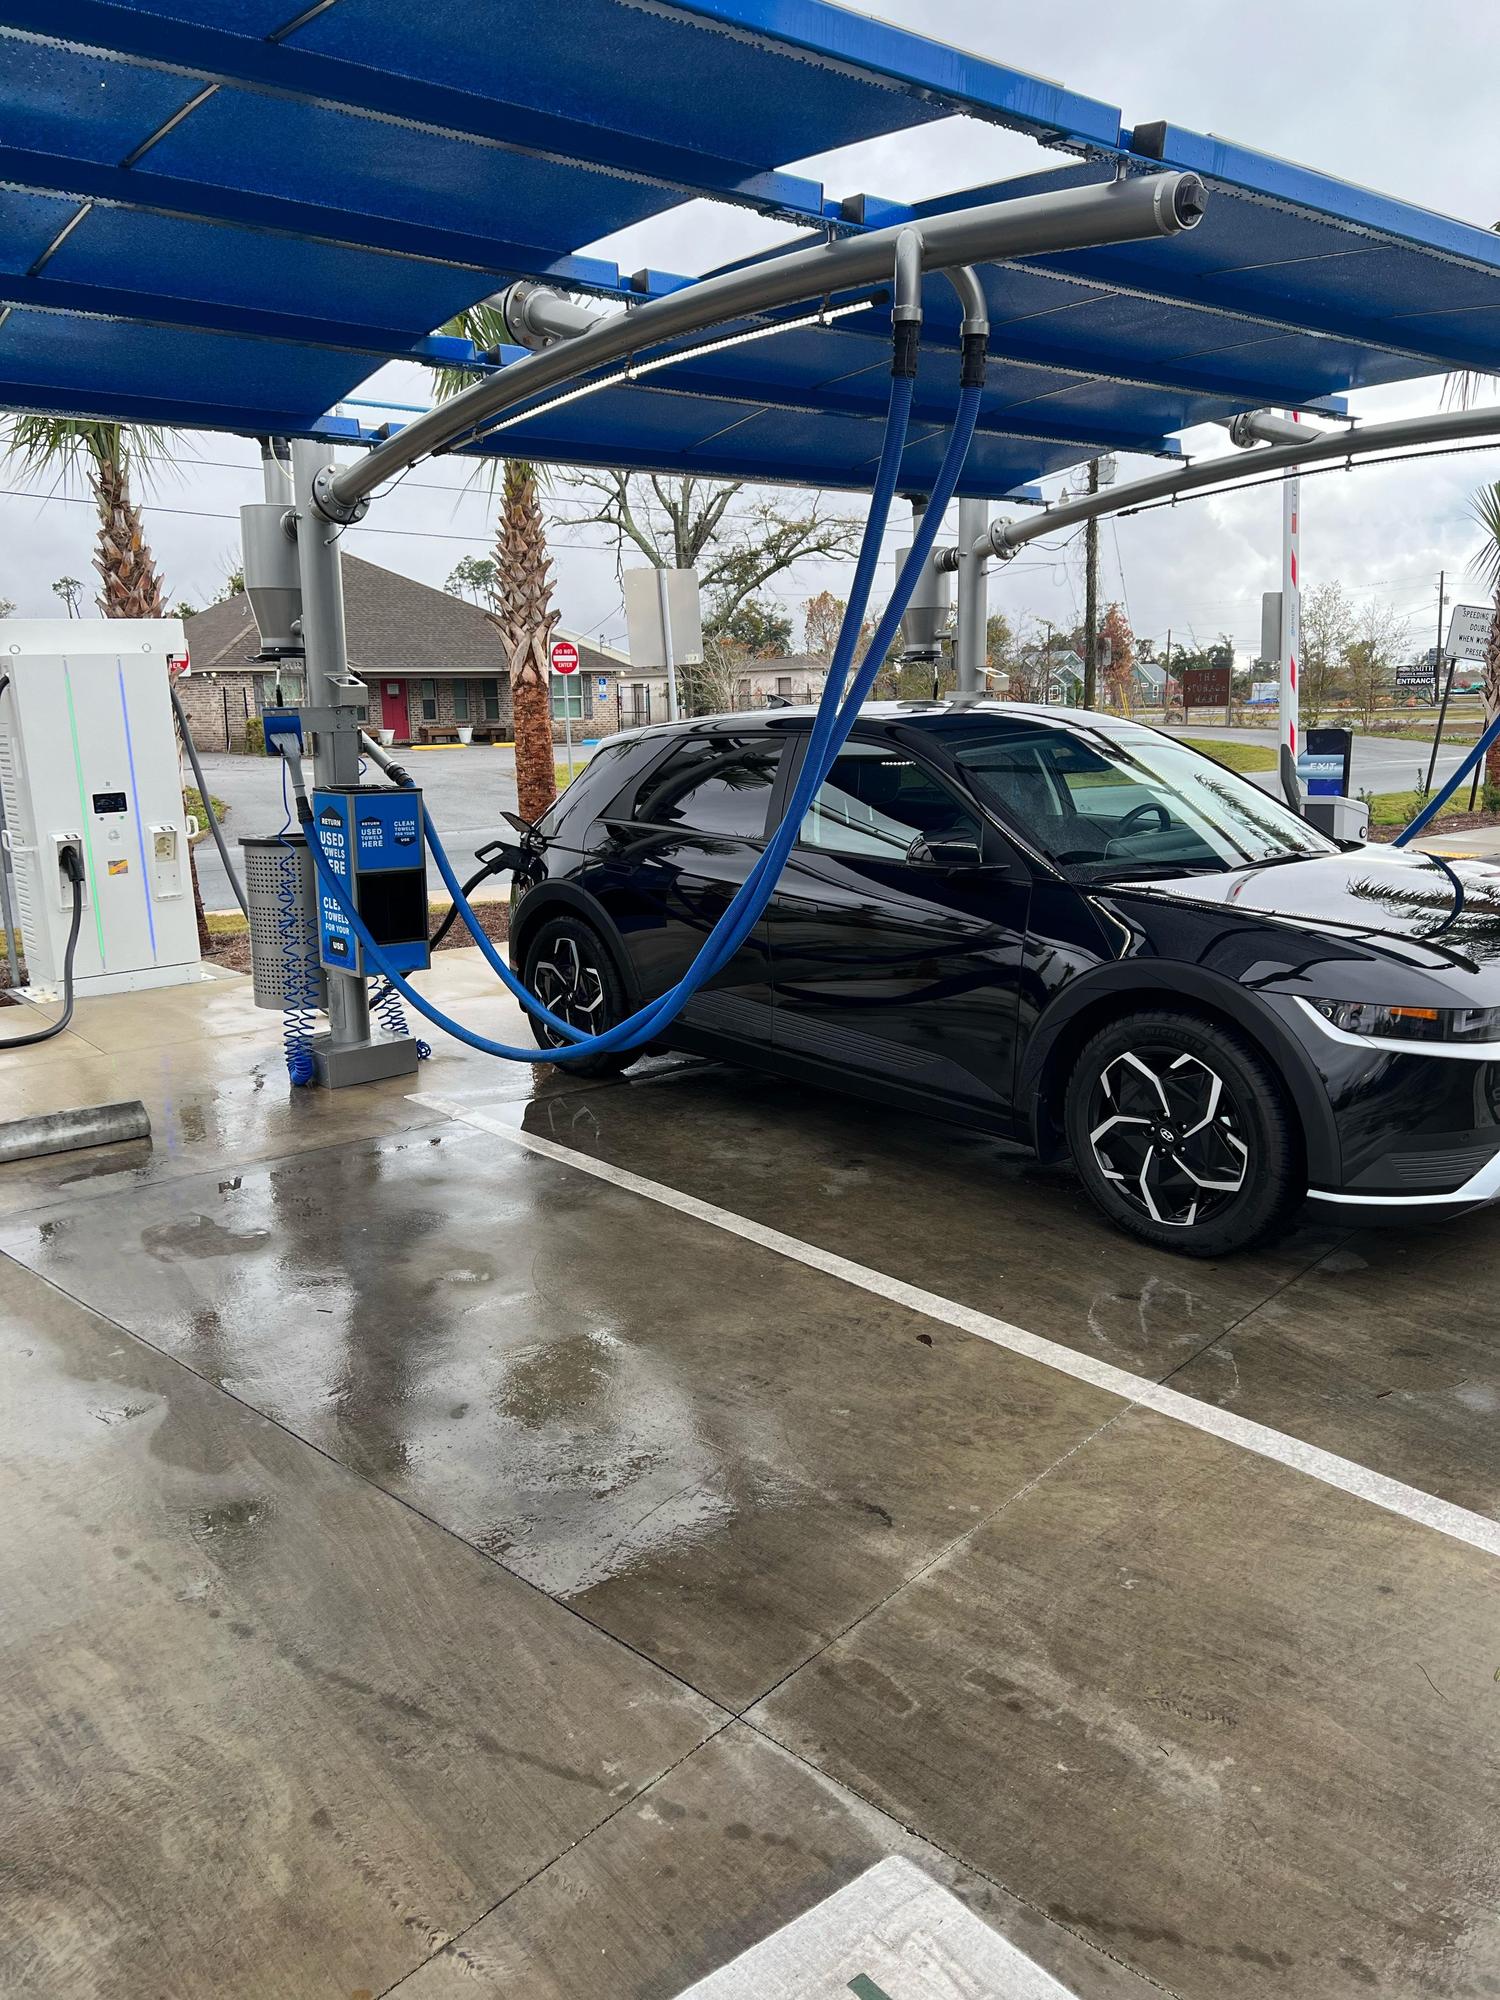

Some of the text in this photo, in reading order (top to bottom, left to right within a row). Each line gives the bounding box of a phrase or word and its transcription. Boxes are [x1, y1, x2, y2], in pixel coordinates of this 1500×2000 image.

[1462, 610, 1490, 620] SPEEDING
[1470, 623, 1492, 634] DOUBLE
[1458, 634, 1474, 643] WHEN
[1310, 762, 1337, 770] EXIT
[321, 817, 342, 827] RETURN
[320, 830, 344, 848] USED
[362, 840, 384, 848] HERE
[322, 846, 346, 859] OWELS
[328, 858, 346, 876] ERE
[323, 896, 342, 911] CLE
[325, 922, 350, 936] FOR YOUR
[332, 941, 344, 951] USE
